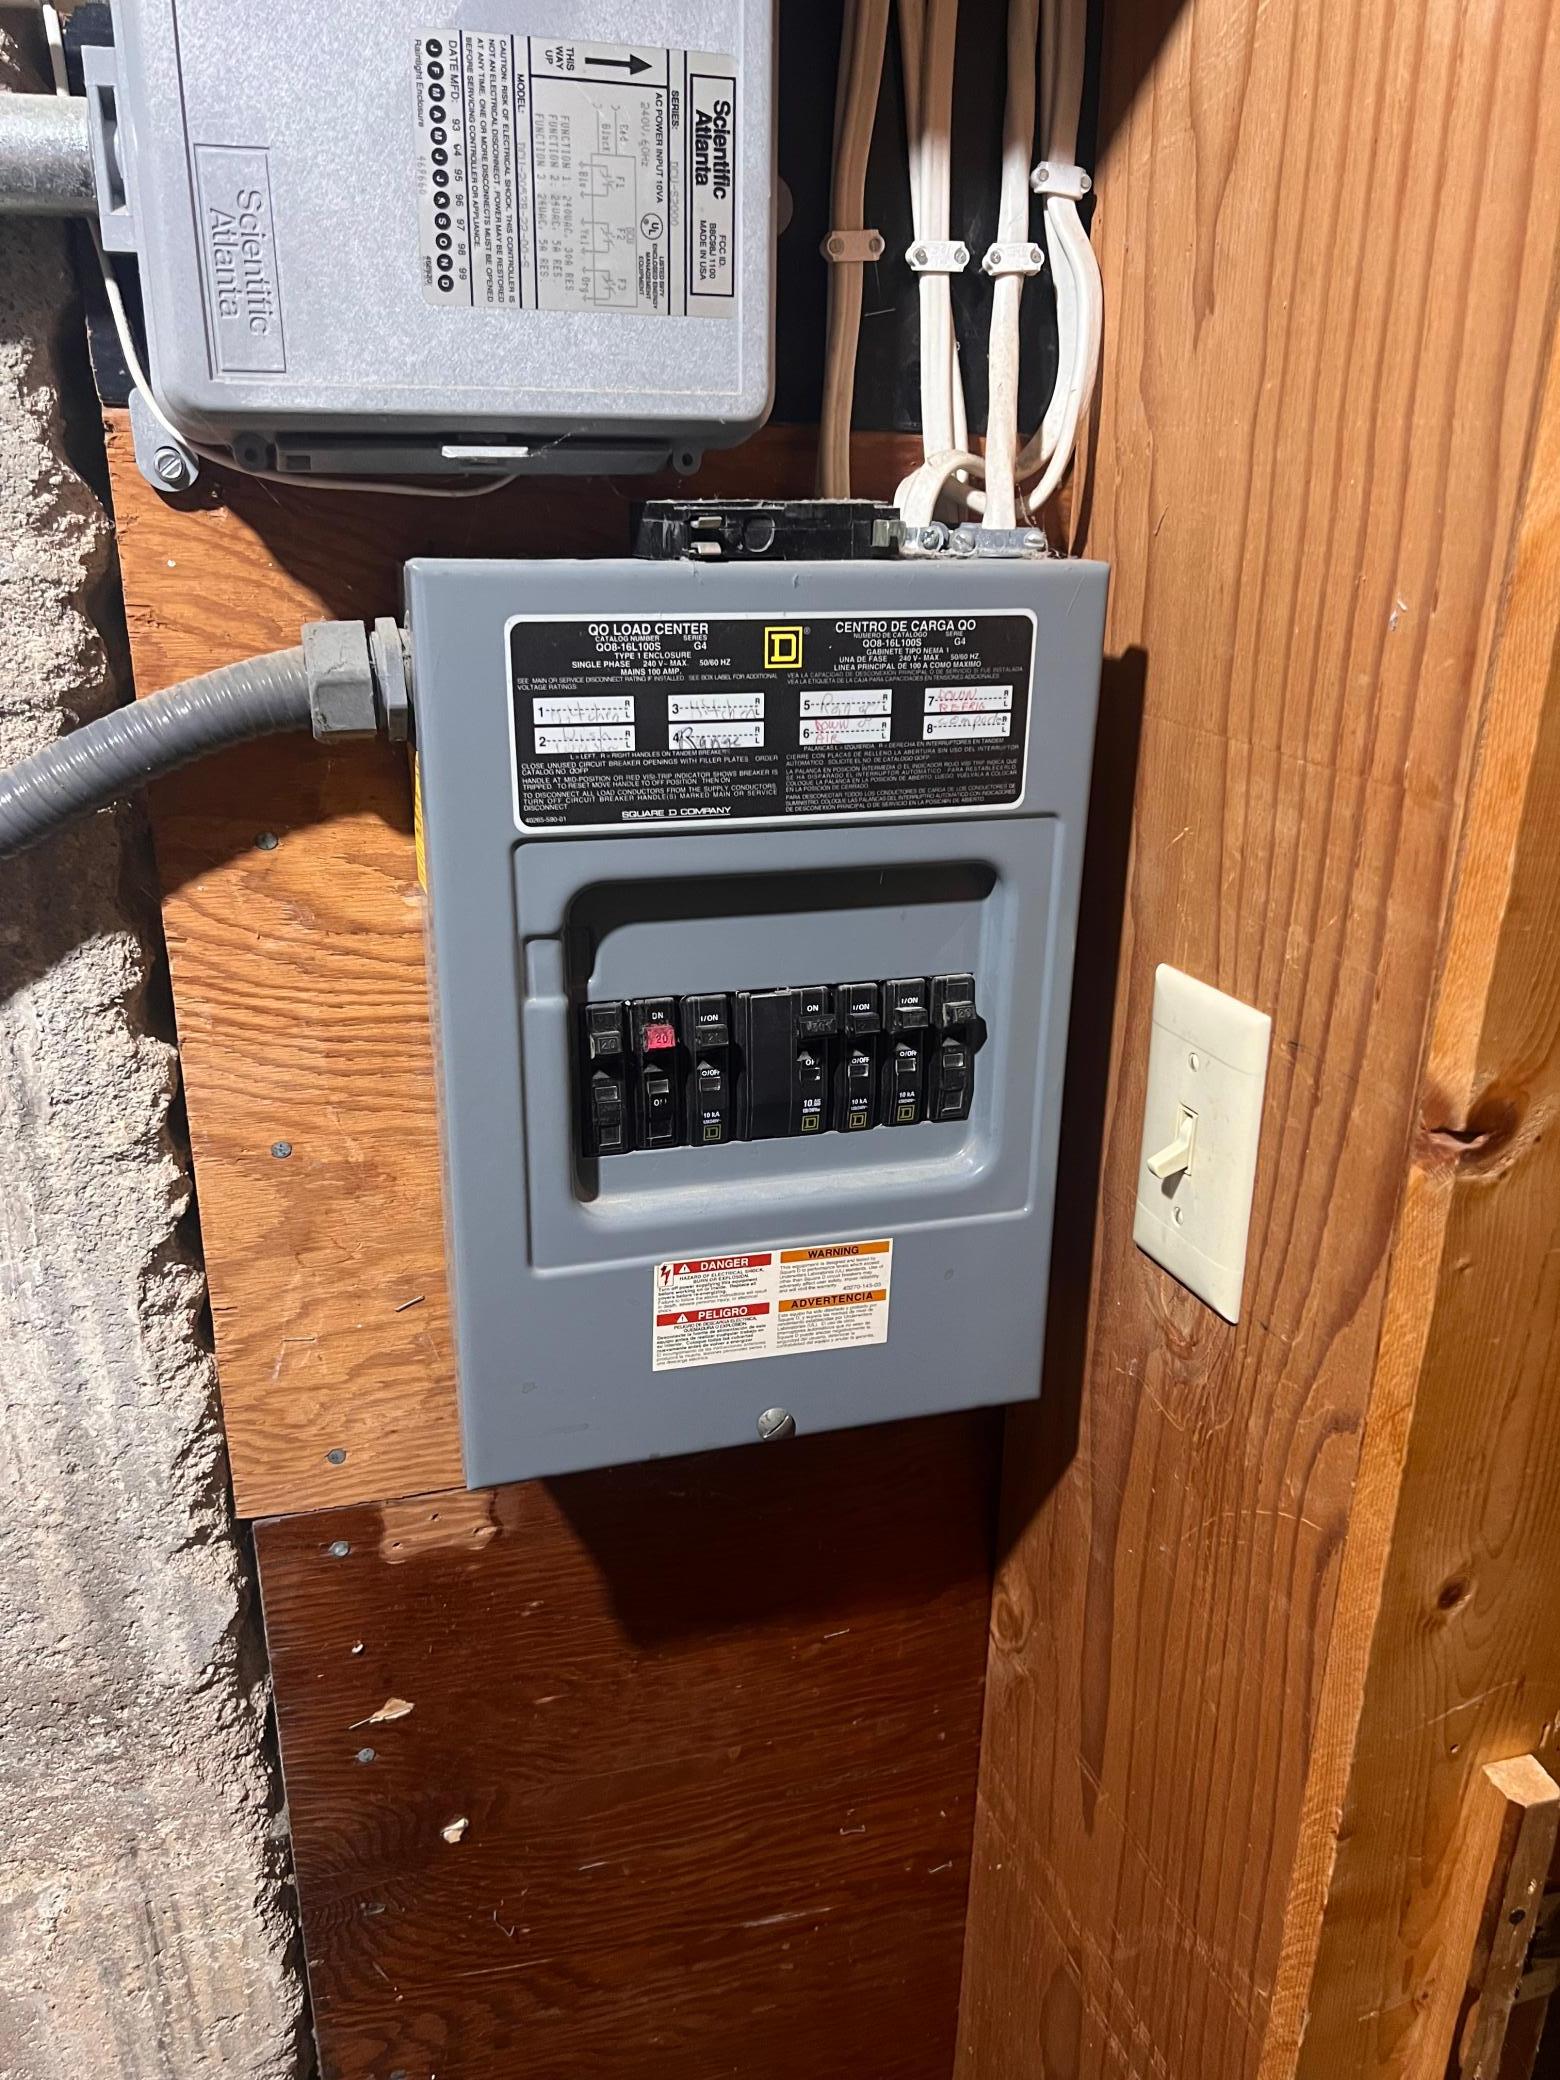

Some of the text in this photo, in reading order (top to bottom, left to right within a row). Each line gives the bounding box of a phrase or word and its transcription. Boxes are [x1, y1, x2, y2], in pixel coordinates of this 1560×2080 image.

[477, 38, 484, 49] AT
[449, 40, 458, 71] DATE
[545, 50, 553, 64] UP
[566, 48, 574, 71] THIS
[490, 60, 496, 72] AN
[450, 74, 459, 103] MFD:
[517, 74, 525, 113] MODEL:
[416, 82, 424, 127] Enclosure
[467, 76, 475, 122] SERVICING
[490, 74, 498, 126] ELECTRICAL
[656, 93, 662, 106] AC
[452, 119, 460, 131] 93
[480, 120, 487, 133] OR
[696, 109, 712, 185] Atlanta
[714, 100, 731, 199] Scientific
[470, 125, 478, 183] CONTROLLER
[455, 169, 463, 181] 95
[472, 186, 478, 198] OR
[482, 164, 491, 225] DISCONNECTS
[456, 194, 463, 206] 96
[502, 109, 509, 120] OF
[507, 236, 515, 292] CONTROLLER
[457, 219, 465, 231] 97
[458, 243, 466, 255] 98
[496, 245, 503, 255] BE
[700, 250, 706, 258] IN
[210, 207, 242, 319] Atlanta
[237, 189, 274, 336] Scientific
[486, 254, 492, 265] BE
[459, 268, 467, 280] 99
[588, 623, 708, 635] QO LOAD CENTER
[836, 620, 976, 633] CENTRO DE CARGA QO
[694, 642, 706, 650] G4
[954, 637, 965, 645] G4
[804, 700, 810, 710] 5
[928, 696, 935, 706] 7
[538, 707, 543, 717] 1
[672, 704, 679, 714] 3
[803, 729, 809, 738] 6
[927, 724, 933, 733] 8
[539, 737, 546, 746] 2
[622, 809, 664, 818] SQUARE
[681, 806, 731, 815] COMPANY
[656, 1034, 668, 1044] 20
[808, 1246, 859, 1259] WARNING
[701, 1258, 749, 1271] DANGER
[791, 1292, 873, 1308] ADVERTENCIA
[698, 1307, 748, 1320] PELIGRO
